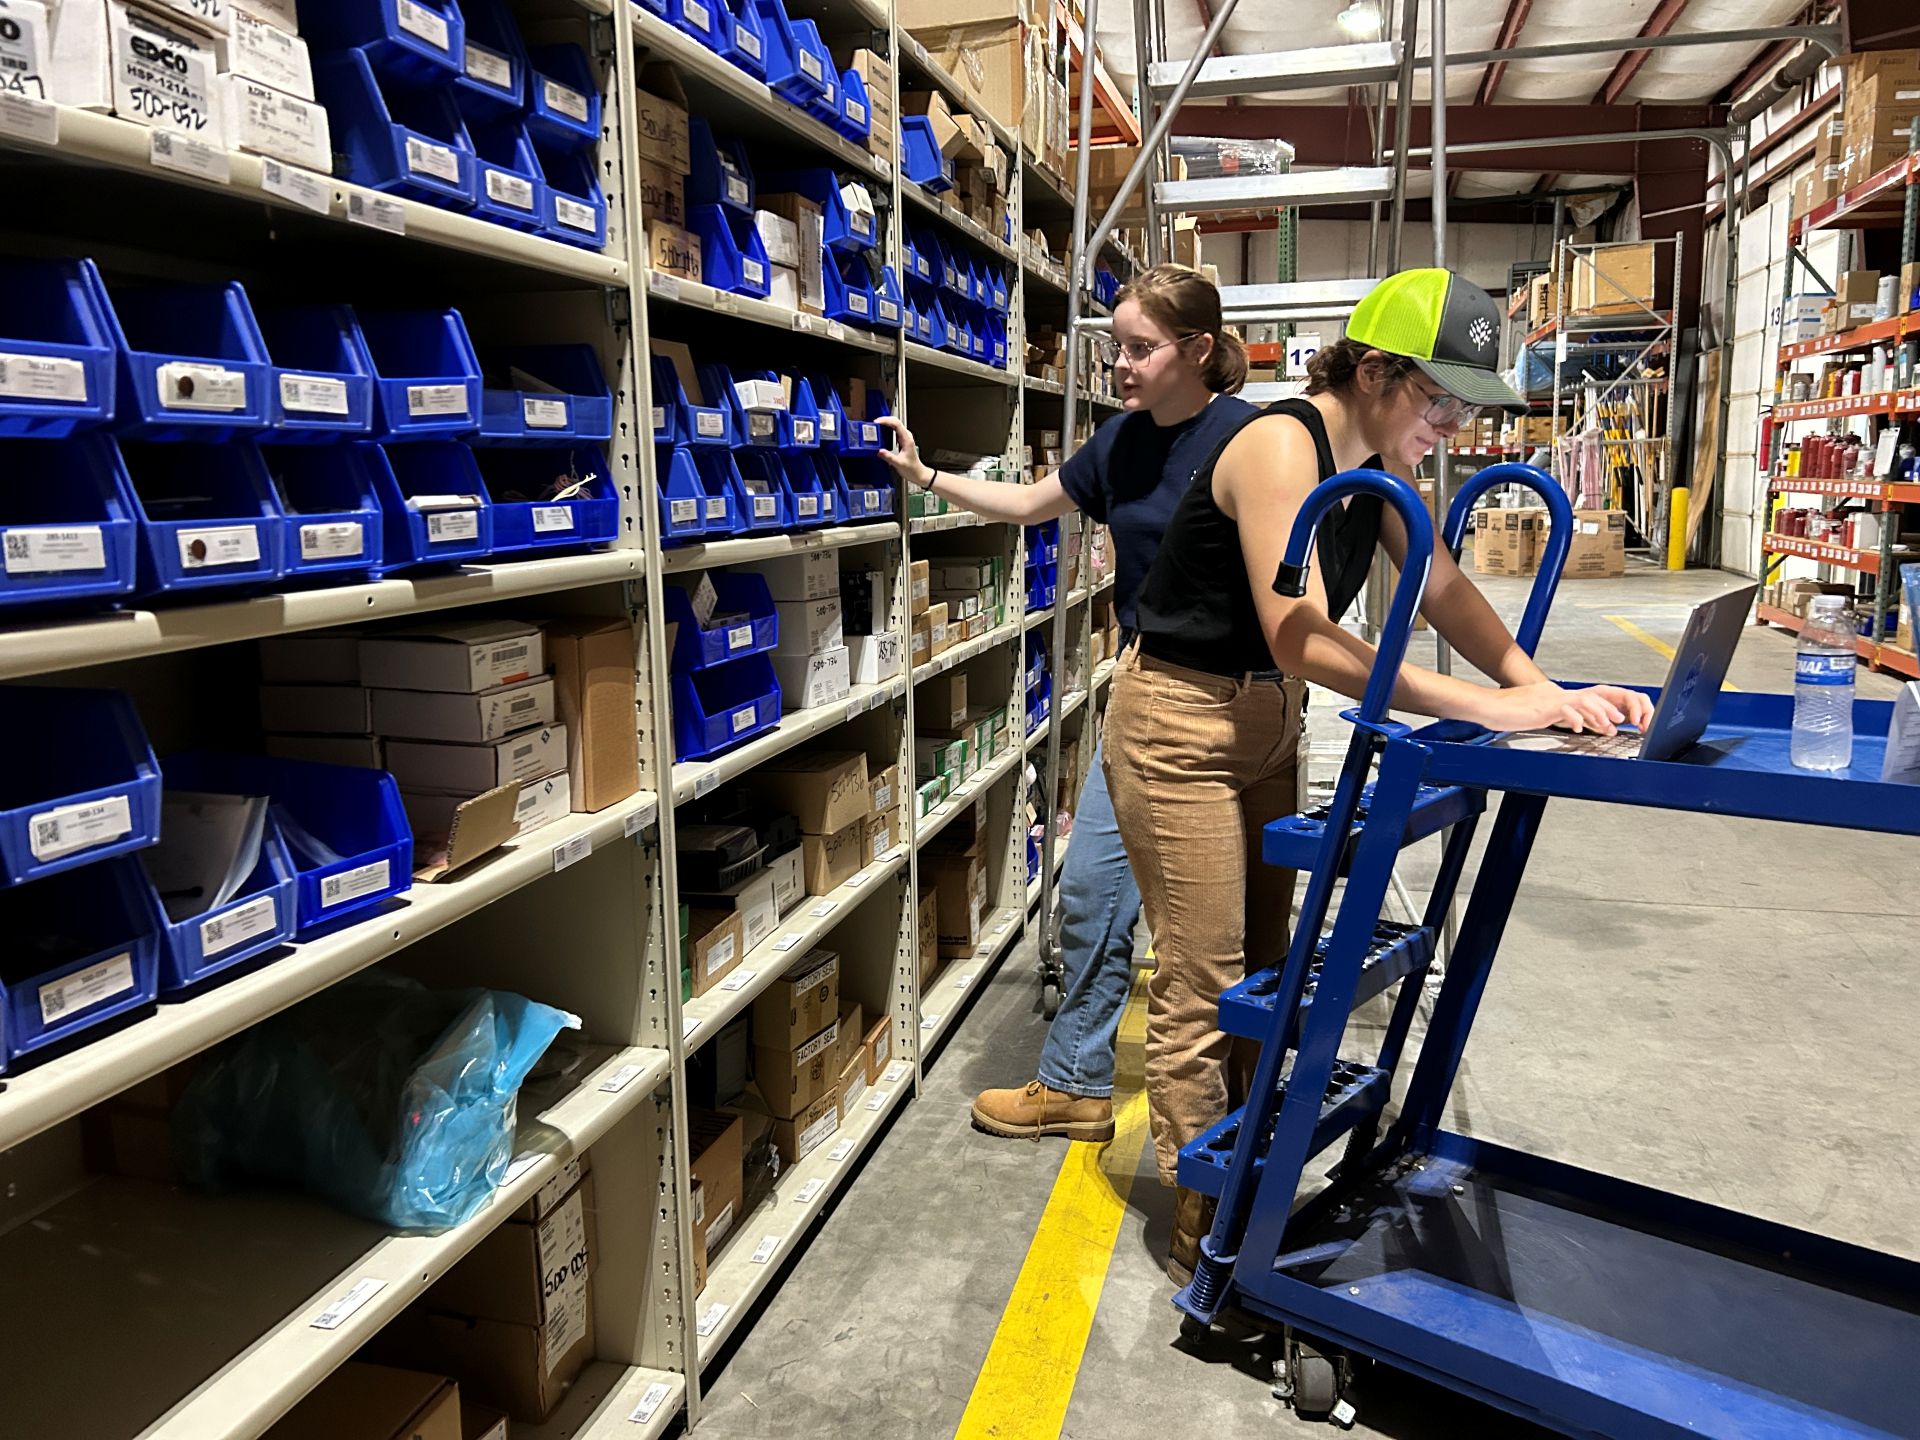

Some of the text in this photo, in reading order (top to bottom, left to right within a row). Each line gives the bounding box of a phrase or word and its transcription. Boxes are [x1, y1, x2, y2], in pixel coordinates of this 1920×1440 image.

[130, 35, 188, 74] EDCO
[1770, 306, 1781, 327] 13
[797, 962, 835, 993] FACTORY SEAL
[798, 1029, 836, 1061] FACTORY SEAL
